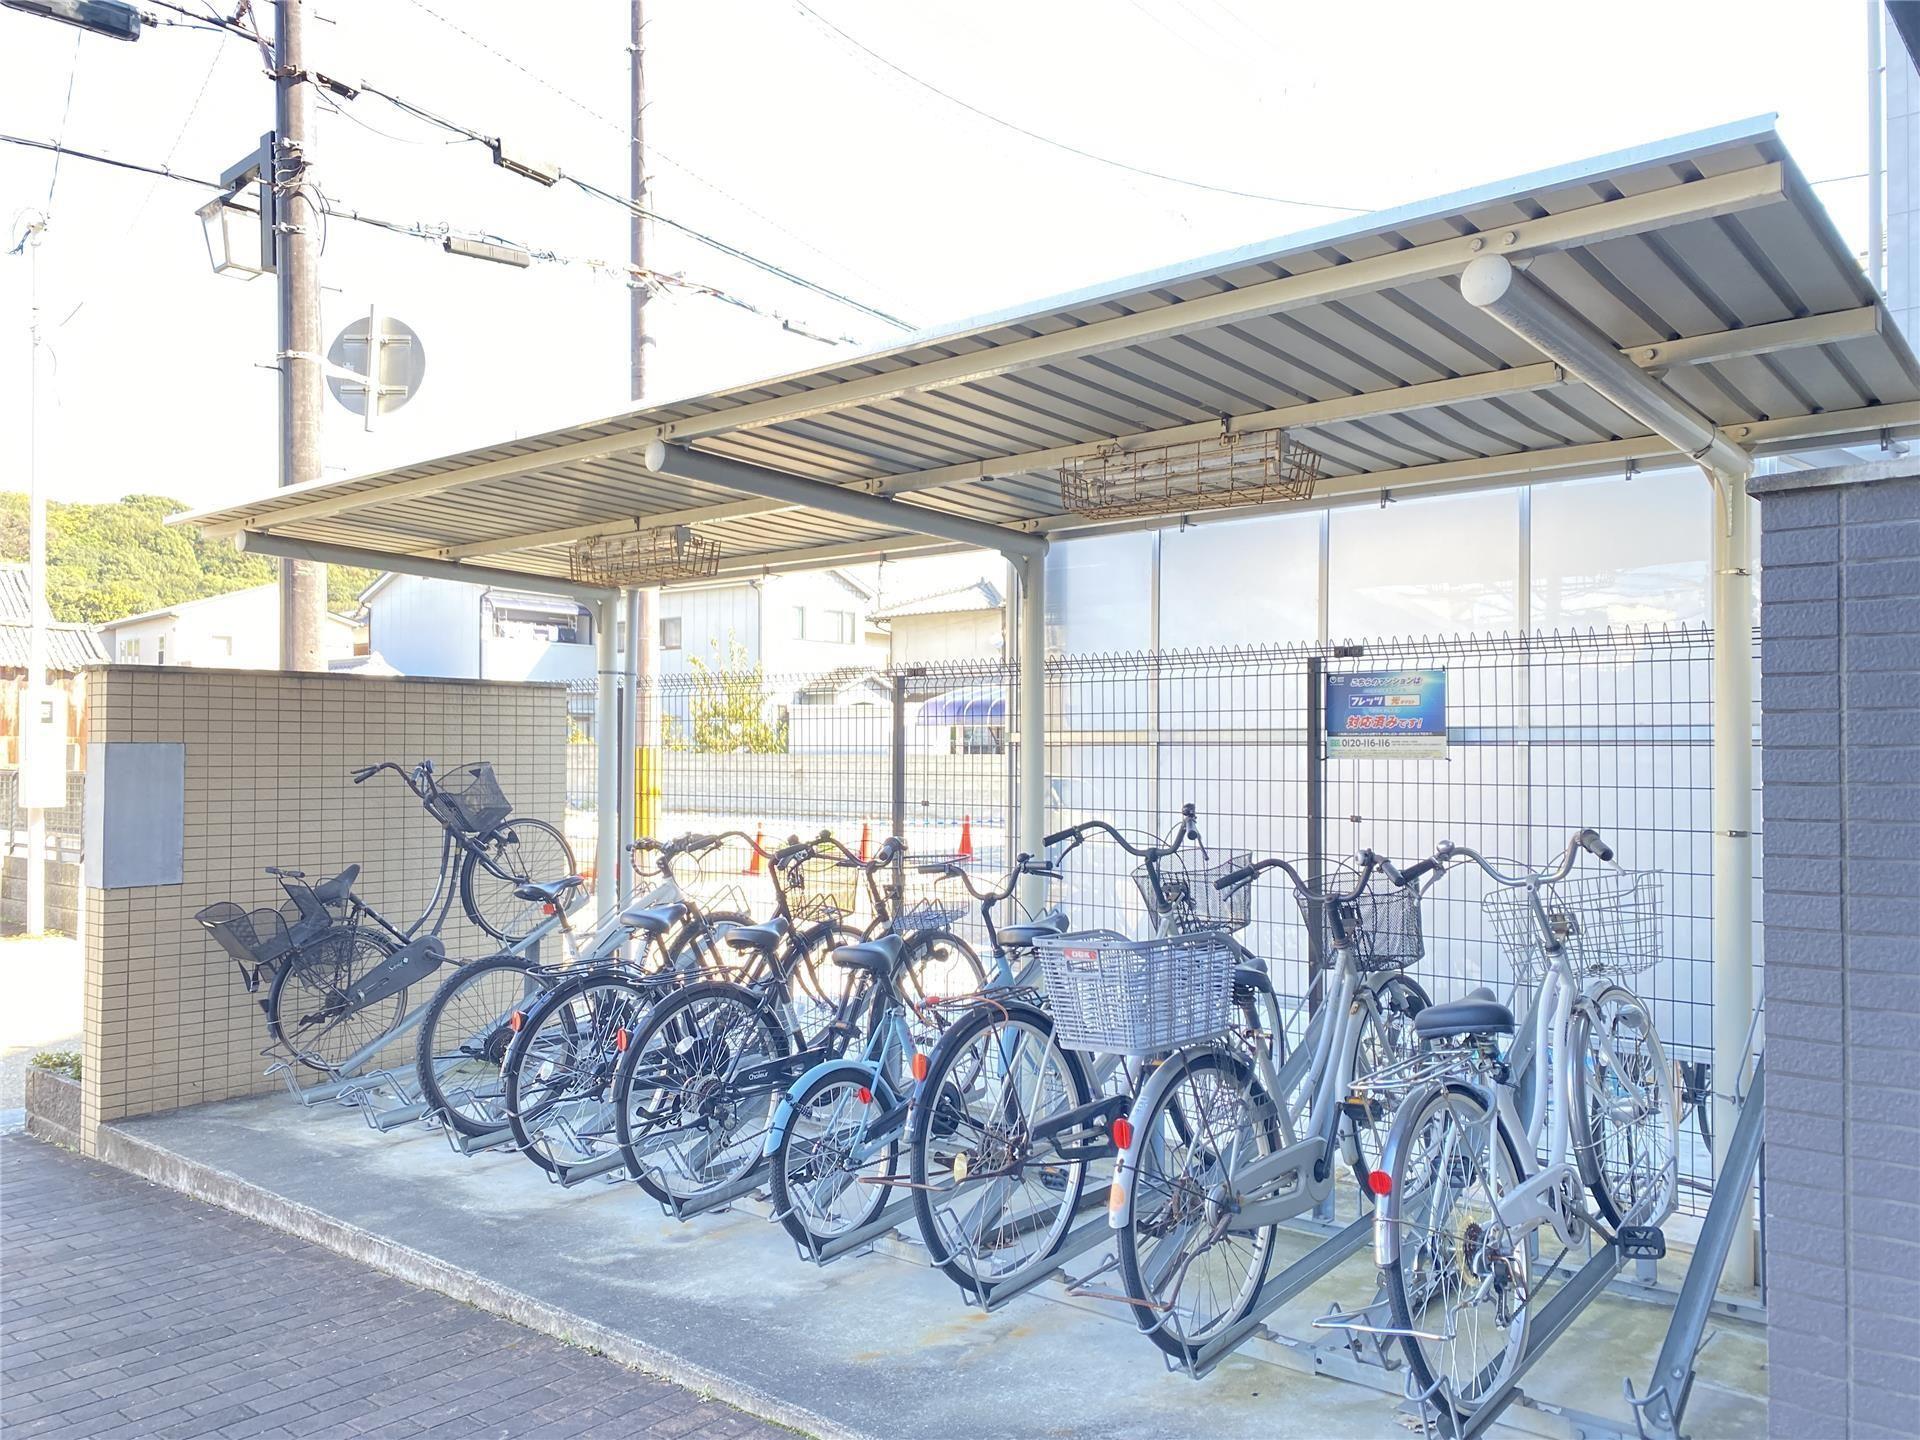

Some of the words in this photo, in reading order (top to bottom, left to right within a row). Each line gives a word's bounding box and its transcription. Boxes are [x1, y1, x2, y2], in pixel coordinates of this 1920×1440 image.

[1350, 677, 1422, 687] こちらのマンションは
[1351, 696, 1383, 706] フレッツ
[1342, 739, 1391, 748] 0120-116-116
